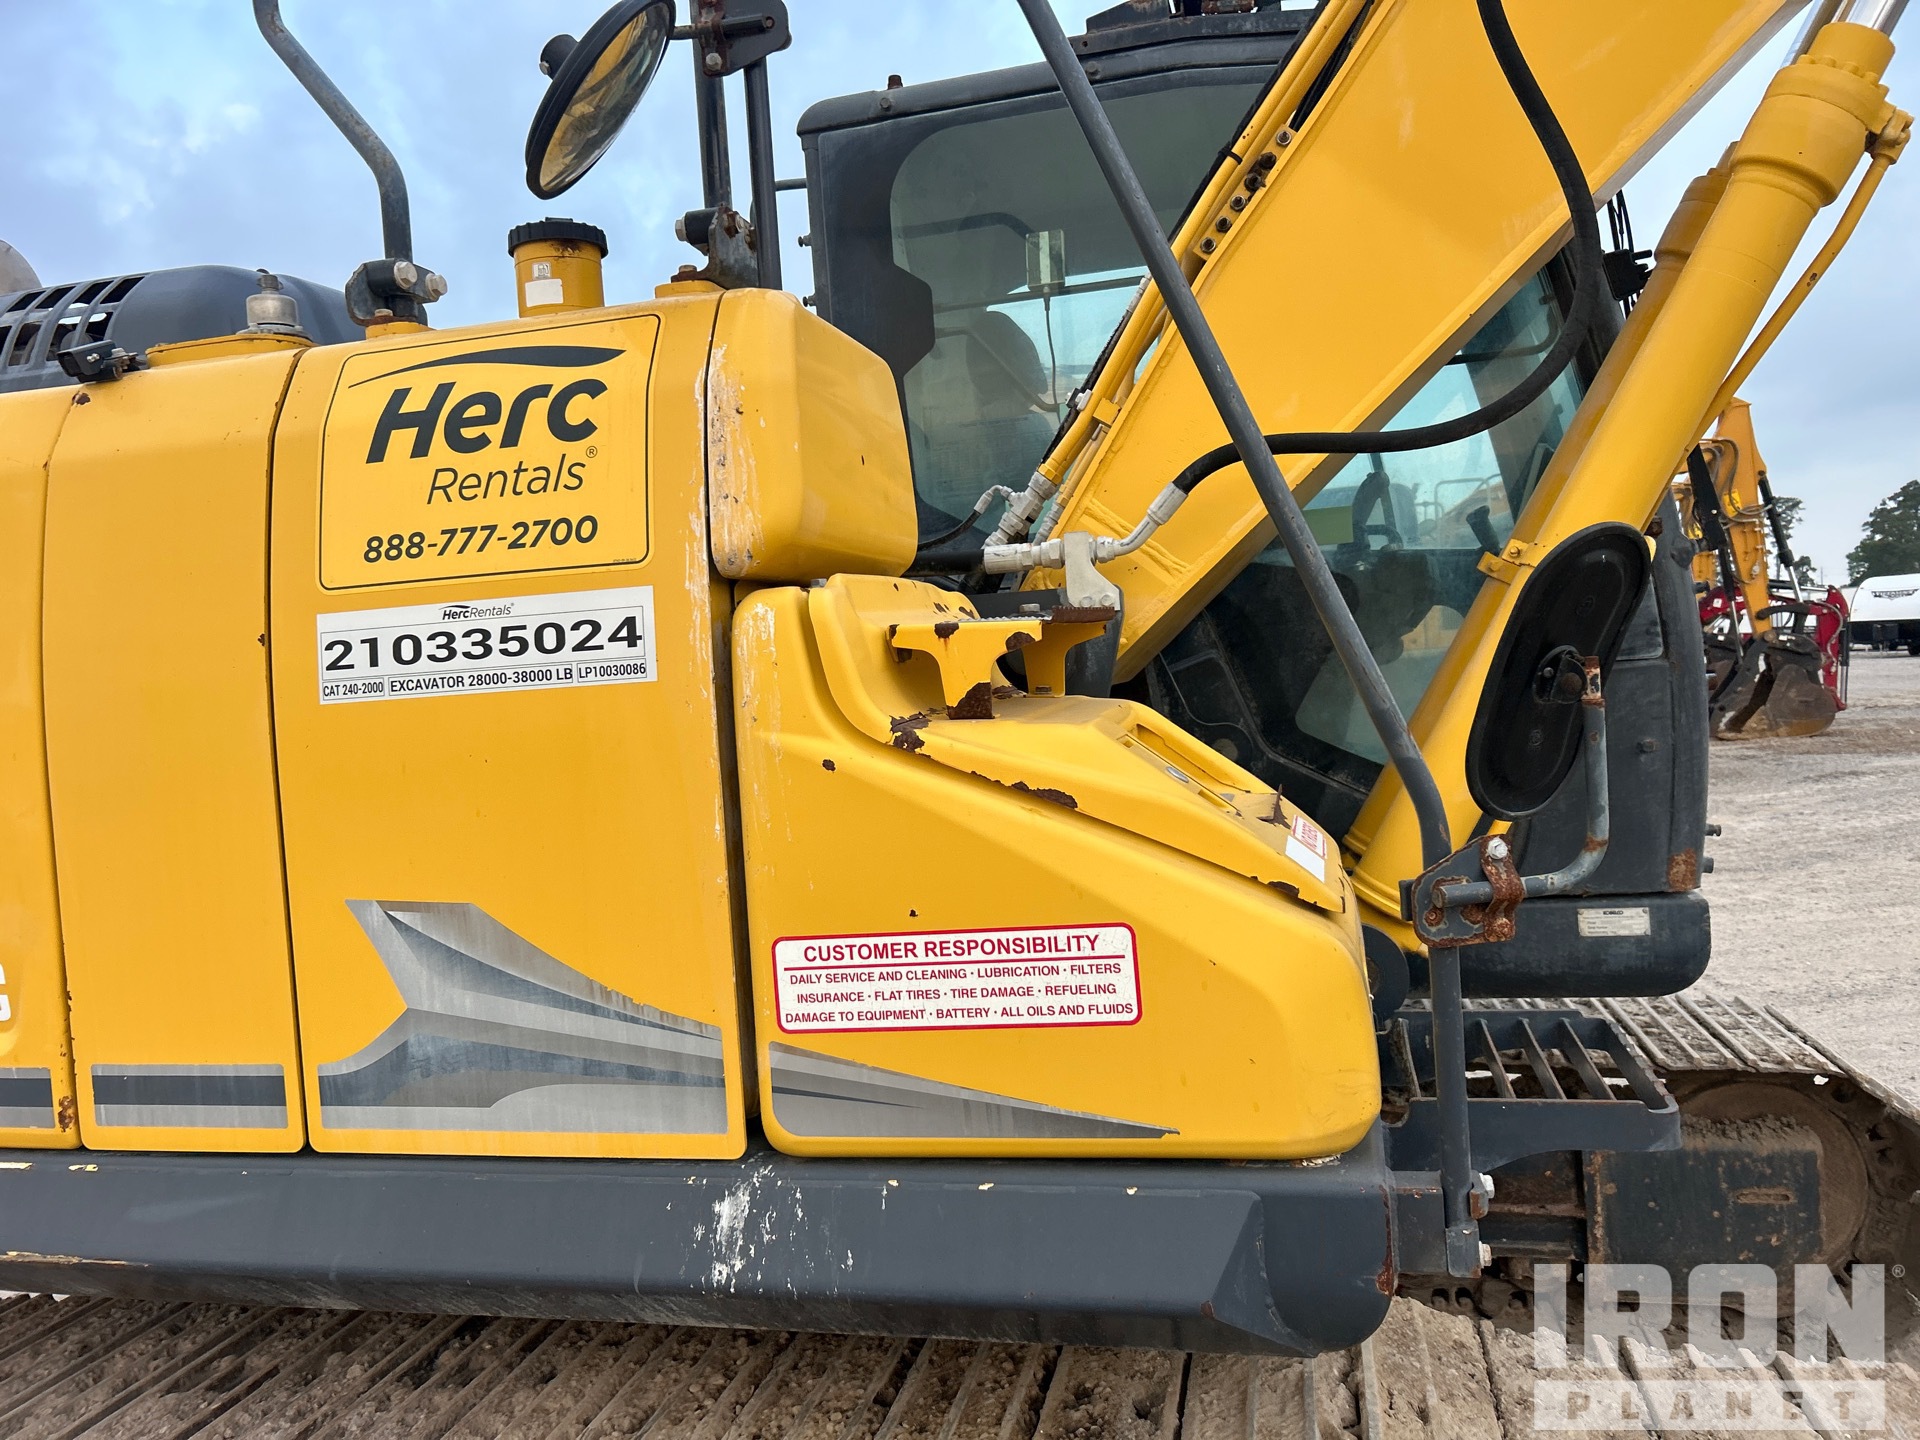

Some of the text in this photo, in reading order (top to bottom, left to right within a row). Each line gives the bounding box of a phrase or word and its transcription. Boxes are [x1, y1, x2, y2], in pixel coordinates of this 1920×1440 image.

[365, 378, 608, 464] Herc
[427, 454, 587, 505] Rentals
[363, 515, 599, 563] 888-777-2700
[324, 616, 643, 672] 210335024
[390, 667, 573, 693] EXCAVATOR 28000-38000 LB
[578, 662, 647, 679] LP10030086
[323, 681, 384, 697] CAT 240-2000
[803, 934, 1100, 963] CUSTOMER RESPONSIBILITY
[790, 962, 1122, 985] DAILY SERVICE AND CLEANING LUBRICATION FILTERS
[797, 982, 1117, 1004] INSURANCE FLAT TIRES TIRE DAMAGE REFUELING
[785, 1003, 1134, 1024] DAMAGE TO EQUIPMENT BATTERY ALL OILS AND FLUIDS
